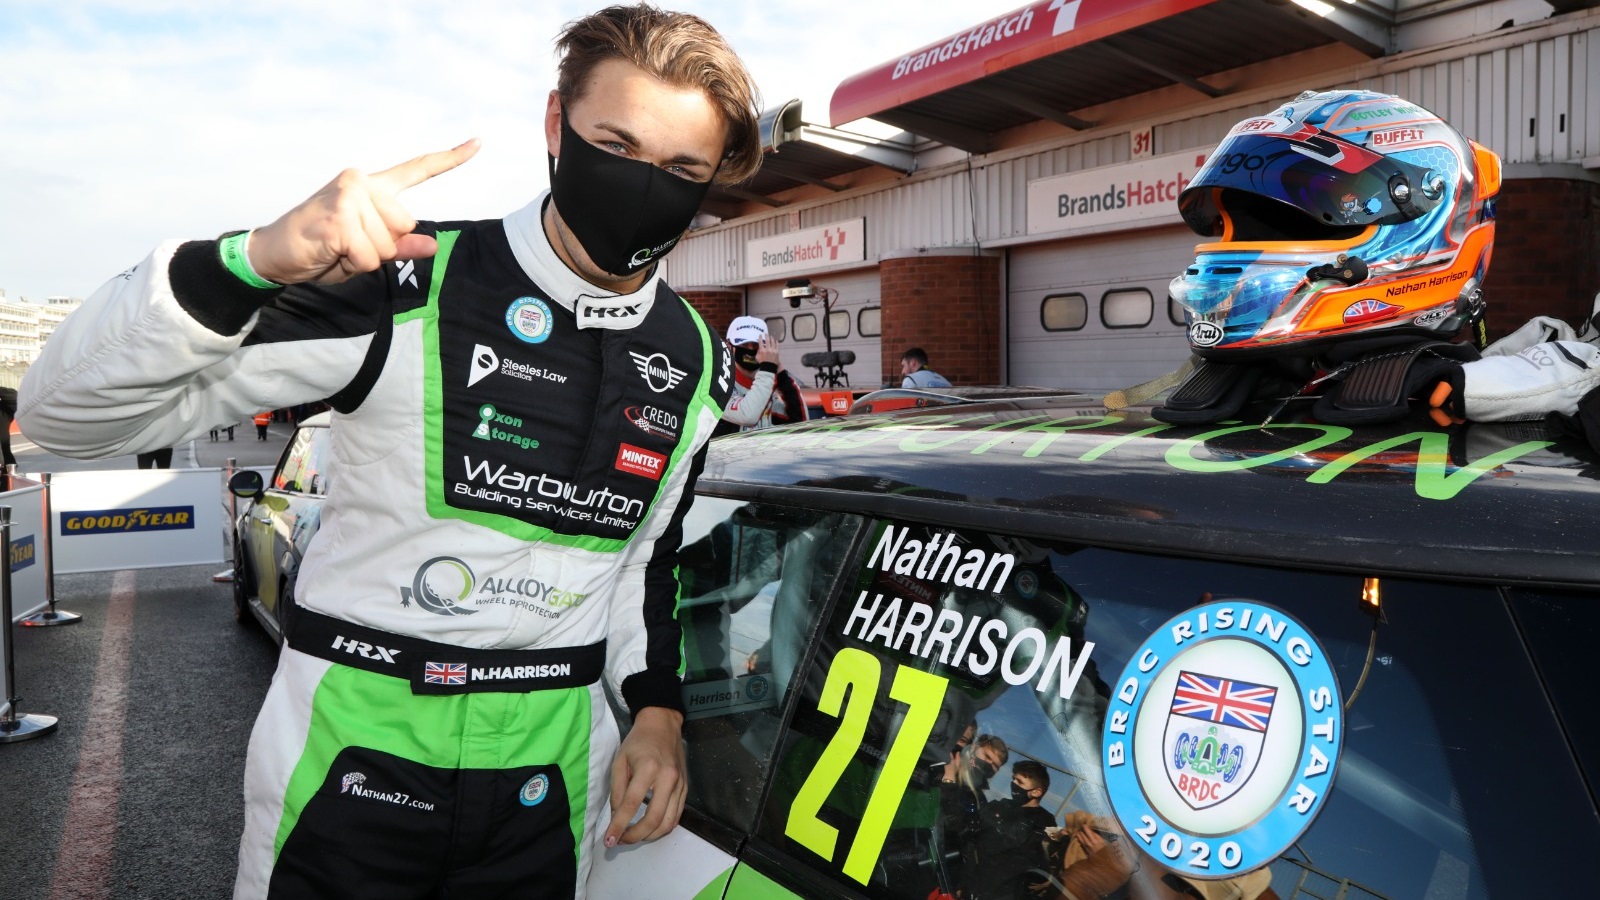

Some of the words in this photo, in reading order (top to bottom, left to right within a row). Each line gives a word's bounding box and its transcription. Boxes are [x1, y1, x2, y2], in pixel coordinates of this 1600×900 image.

[892, 7, 1034, 80] BrandsHatch
[1133, 131, 1150, 155] 31
[1373, 130, 1424, 145] BUFF-IT
[1058, 172, 1192, 218] BrandsHatch
[762, 241, 823, 268] BrandsHatch
[1386, 281, 1427, 297] Nathan
[1428, 270, 1468, 288] Harrison
[583, 303, 642, 318] HRX
[1192, 325, 1217, 339] Arai
[501, 367, 533, 382] Solicitors
[502, 358, 541, 377] Steeles
[542, 368, 568, 383] Law
[648, 364, 669, 381] MINI
[642, 405, 678, 429] CREDO
[832, 400, 848, 410] CAM
[621, 448, 662, 470] MINTEX
[463, 455, 644, 518] Warburton
[454, 482, 522, 509] Building
[594, 514, 637, 530] Limited
[66, 511, 189, 530] GOODYEAR
[866, 524, 1015, 595] Nathan
[475, 596, 507, 606] WHEEL
[332, 635, 402, 665] HRX
[842, 590, 1095, 700] HARRISON
[471, 663, 571, 682] N.HARRISON
[690, 690, 741, 706] Harrison
[1108, 647, 1159, 768] BRDC
[1171, 608, 1313, 667] RISING
[1287, 685, 1335, 815] STAR
[784, 647, 950, 888] 27
[1177, 772, 1222, 802] BRDC
[1134, 814, 1243, 869] 2020
